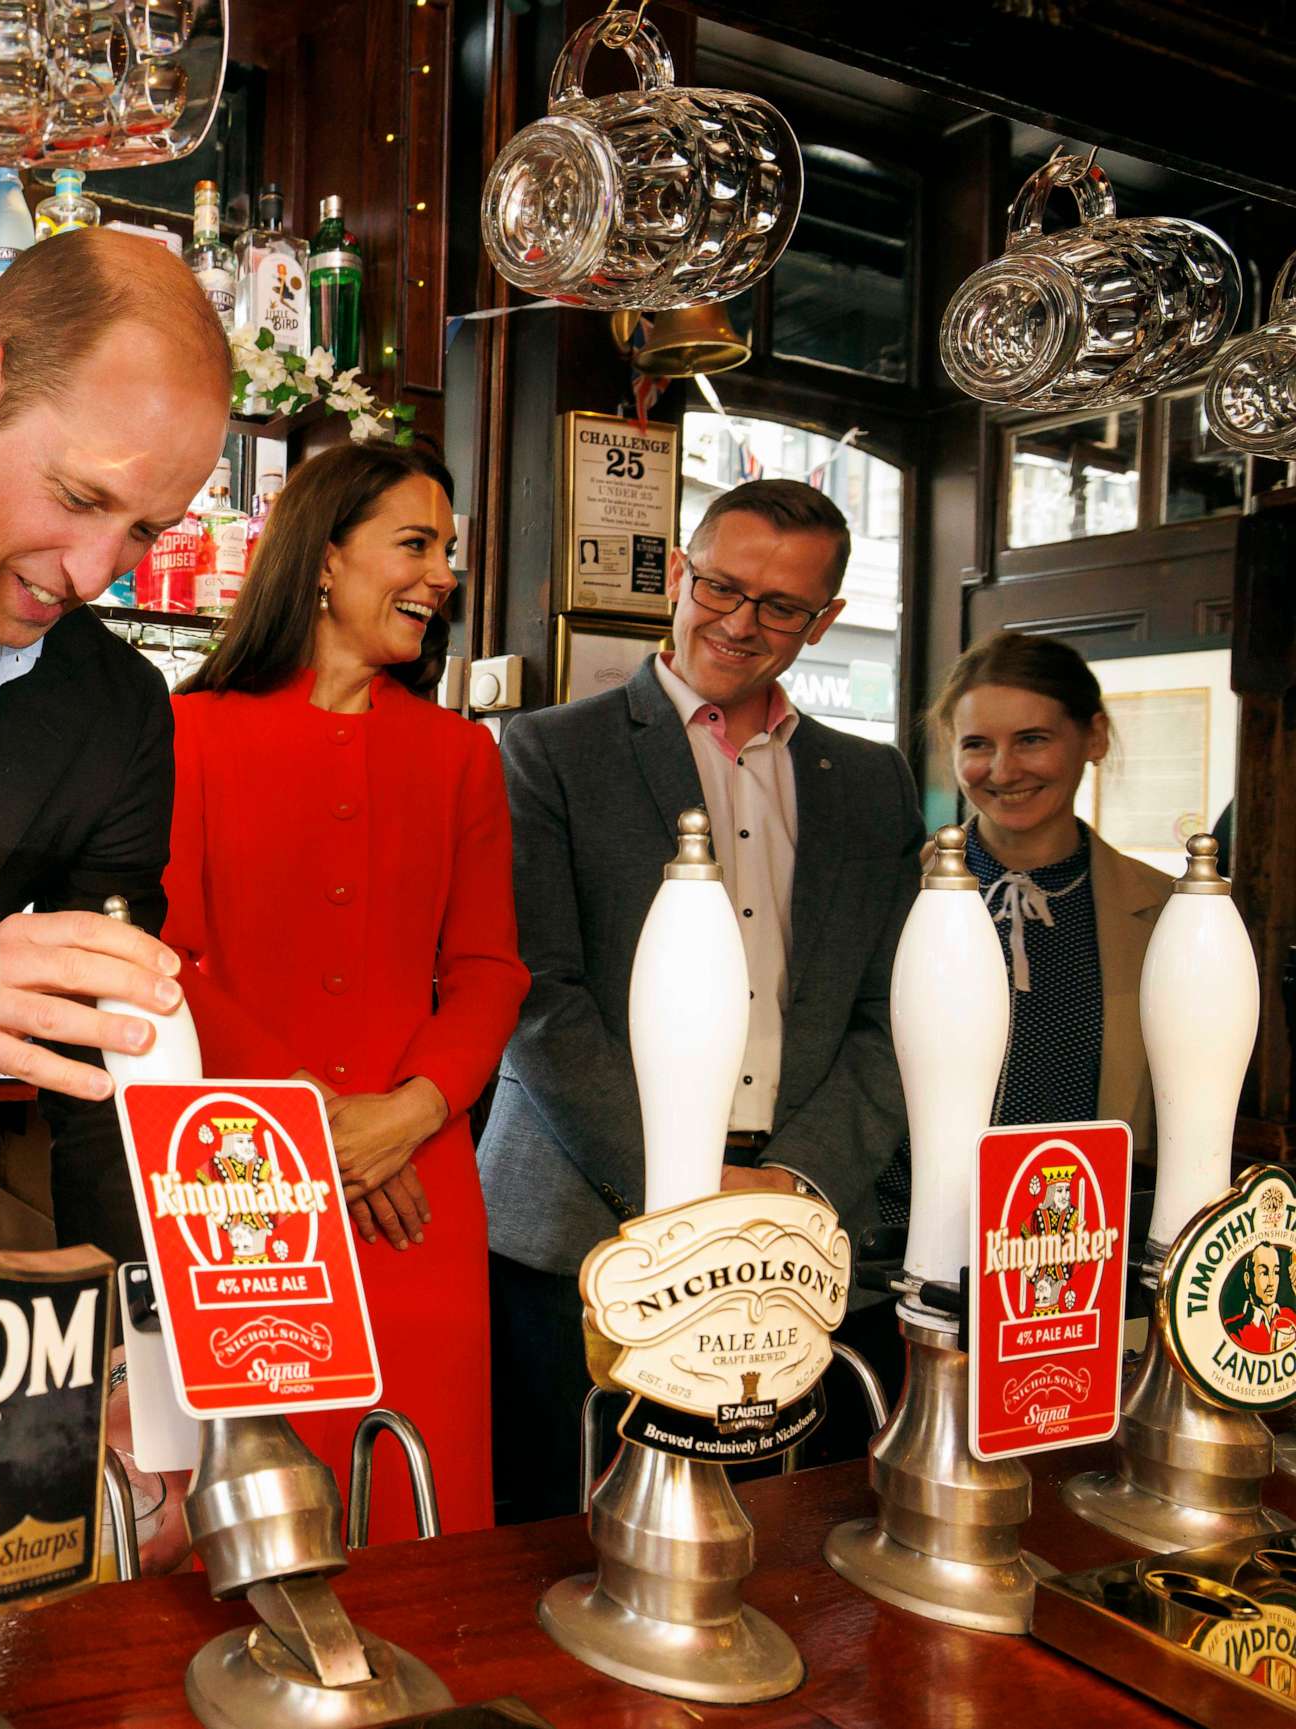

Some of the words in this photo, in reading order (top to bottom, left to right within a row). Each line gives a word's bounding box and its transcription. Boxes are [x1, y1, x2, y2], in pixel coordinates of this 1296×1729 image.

[265, 309, 289, 321] LITTLE
[273, 319, 299, 331] BIRD
[579, 430, 670, 454] CHALLENGE
[606, 448, 645, 480] 25
[598, 485, 638, 499] UNDER
[604, 505, 634, 518] OVER
[153, 552, 191, 568] HOUSE
[150, 1170, 330, 1225] Kingmaker
[984, 1219, 1120, 1277] Kingmaker
[1188, 1206, 1257, 1318] TIMOTHY
[215, 1277, 240, 1295] 4%
[242, 1276, 278, 1293] PALE
[281, 1274, 308, 1291] ALE
[632, 1259, 840, 1321] NICHOLSON'S
[224, 1327, 322, 1357] NICHOLSON'S
[697, 1332, 756, 1353] PALE
[761, 1327, 799, 1349] ALE
[1016, 1330, 1034, 1345] 4%
[1035, 1326, 1062, 1343] PALE
[1064, 1324, 1083, 1339] ALE
[712, 1353, 747, 1366] CRAFT
[748, 1350, 787, 1363] BREWED
[1212, 1339, 1296, 1386] LANDLO
[246, 1357, 311, 1393] Signal
[280, 1384, 315, 1395] LONDON
[1012, 1375, 1082, 1405] NICHOLSON'S
[1226, 1381, 1257, 1397] CLASSIC
[643, 1421, 694, 1451] Brewed
[695, 1438, 758, 1456] exclusively
[759, 1436, 775, 1450] for
[775, 1407, 817, 1445] Nicholsons
[1024, 1403, 1071, 1434] Signal
